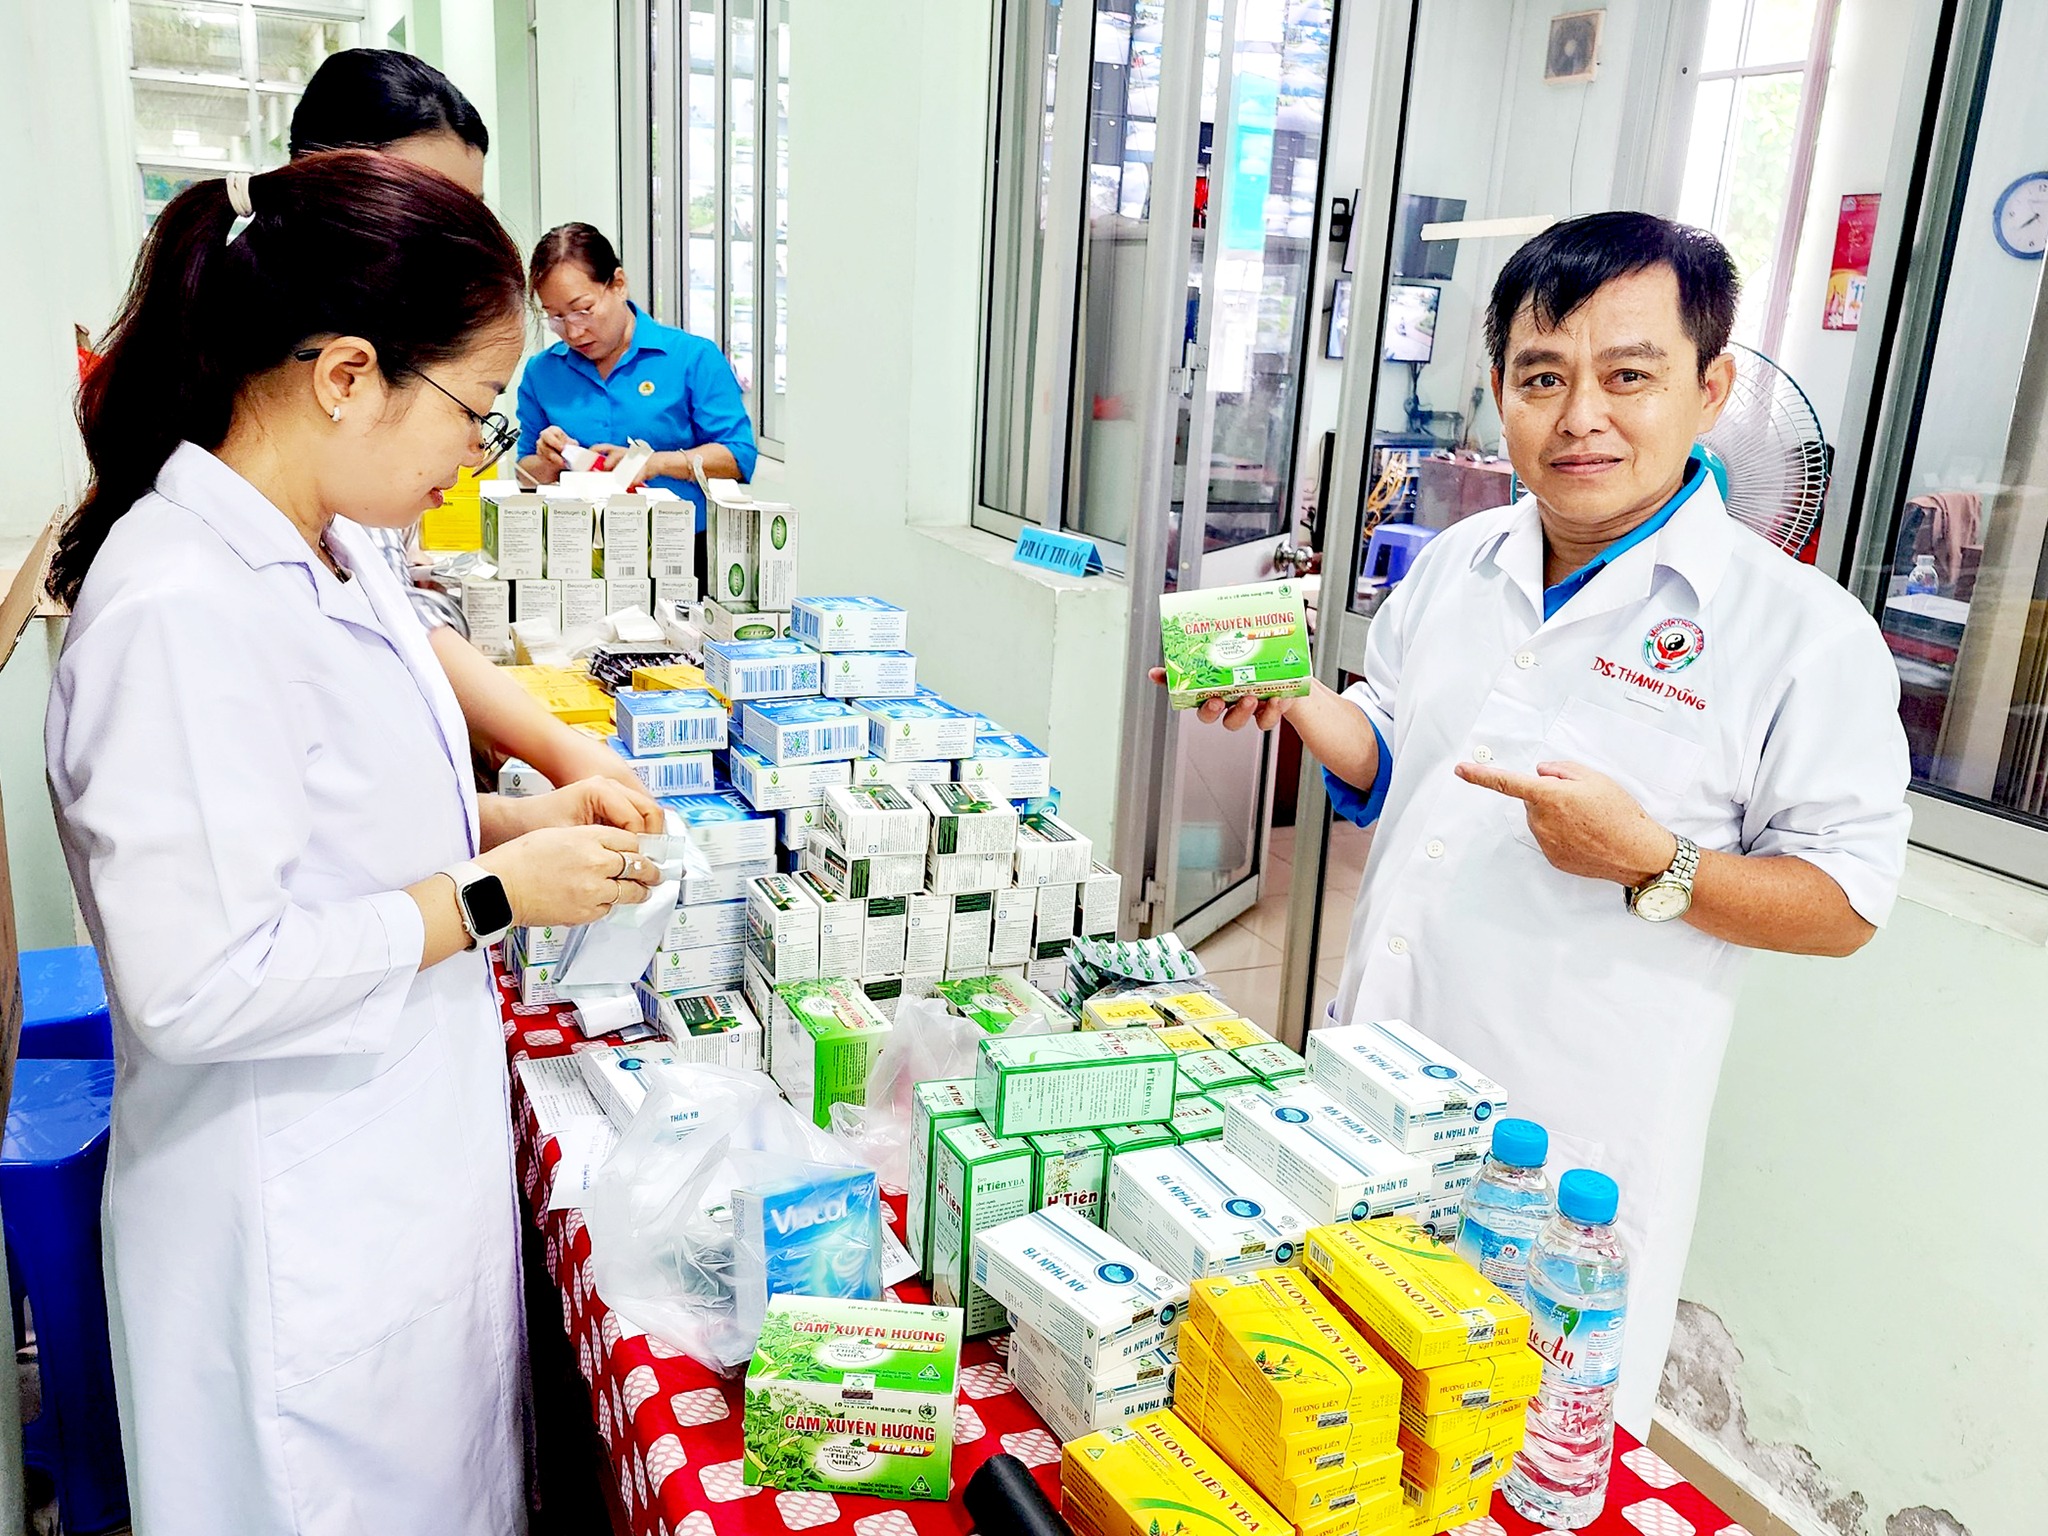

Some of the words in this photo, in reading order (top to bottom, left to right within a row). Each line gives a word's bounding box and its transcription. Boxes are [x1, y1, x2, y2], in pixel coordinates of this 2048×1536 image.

[977, 1180, 1007, 1193] H'Tiên
[1363, 1186, 1374, 1196] AN
[1077, 1208, 1096, 1218] BA
[1430, 1209, 1441, 1219] AN
[1274, 1275, 1317, 1315] HƯƠNG
[1312, 1316, 1344, 1345] LIÊN
[1338, 1346, 1368, 1375] YBA
[891, 1329, 946, 1343] HƯƠNG
[785, 1411, 820, 1431] CẢM
[825, 1418, 876, 1437] XUYÊN
[882, 1423, 936, 1442] HƯƠNG
[1145, 1422, 1196, 1468] HƯƠNG
[1193, 1469, 1230, 1501] LIÊN
[1227, 1501, 1261, 1533] YBA
